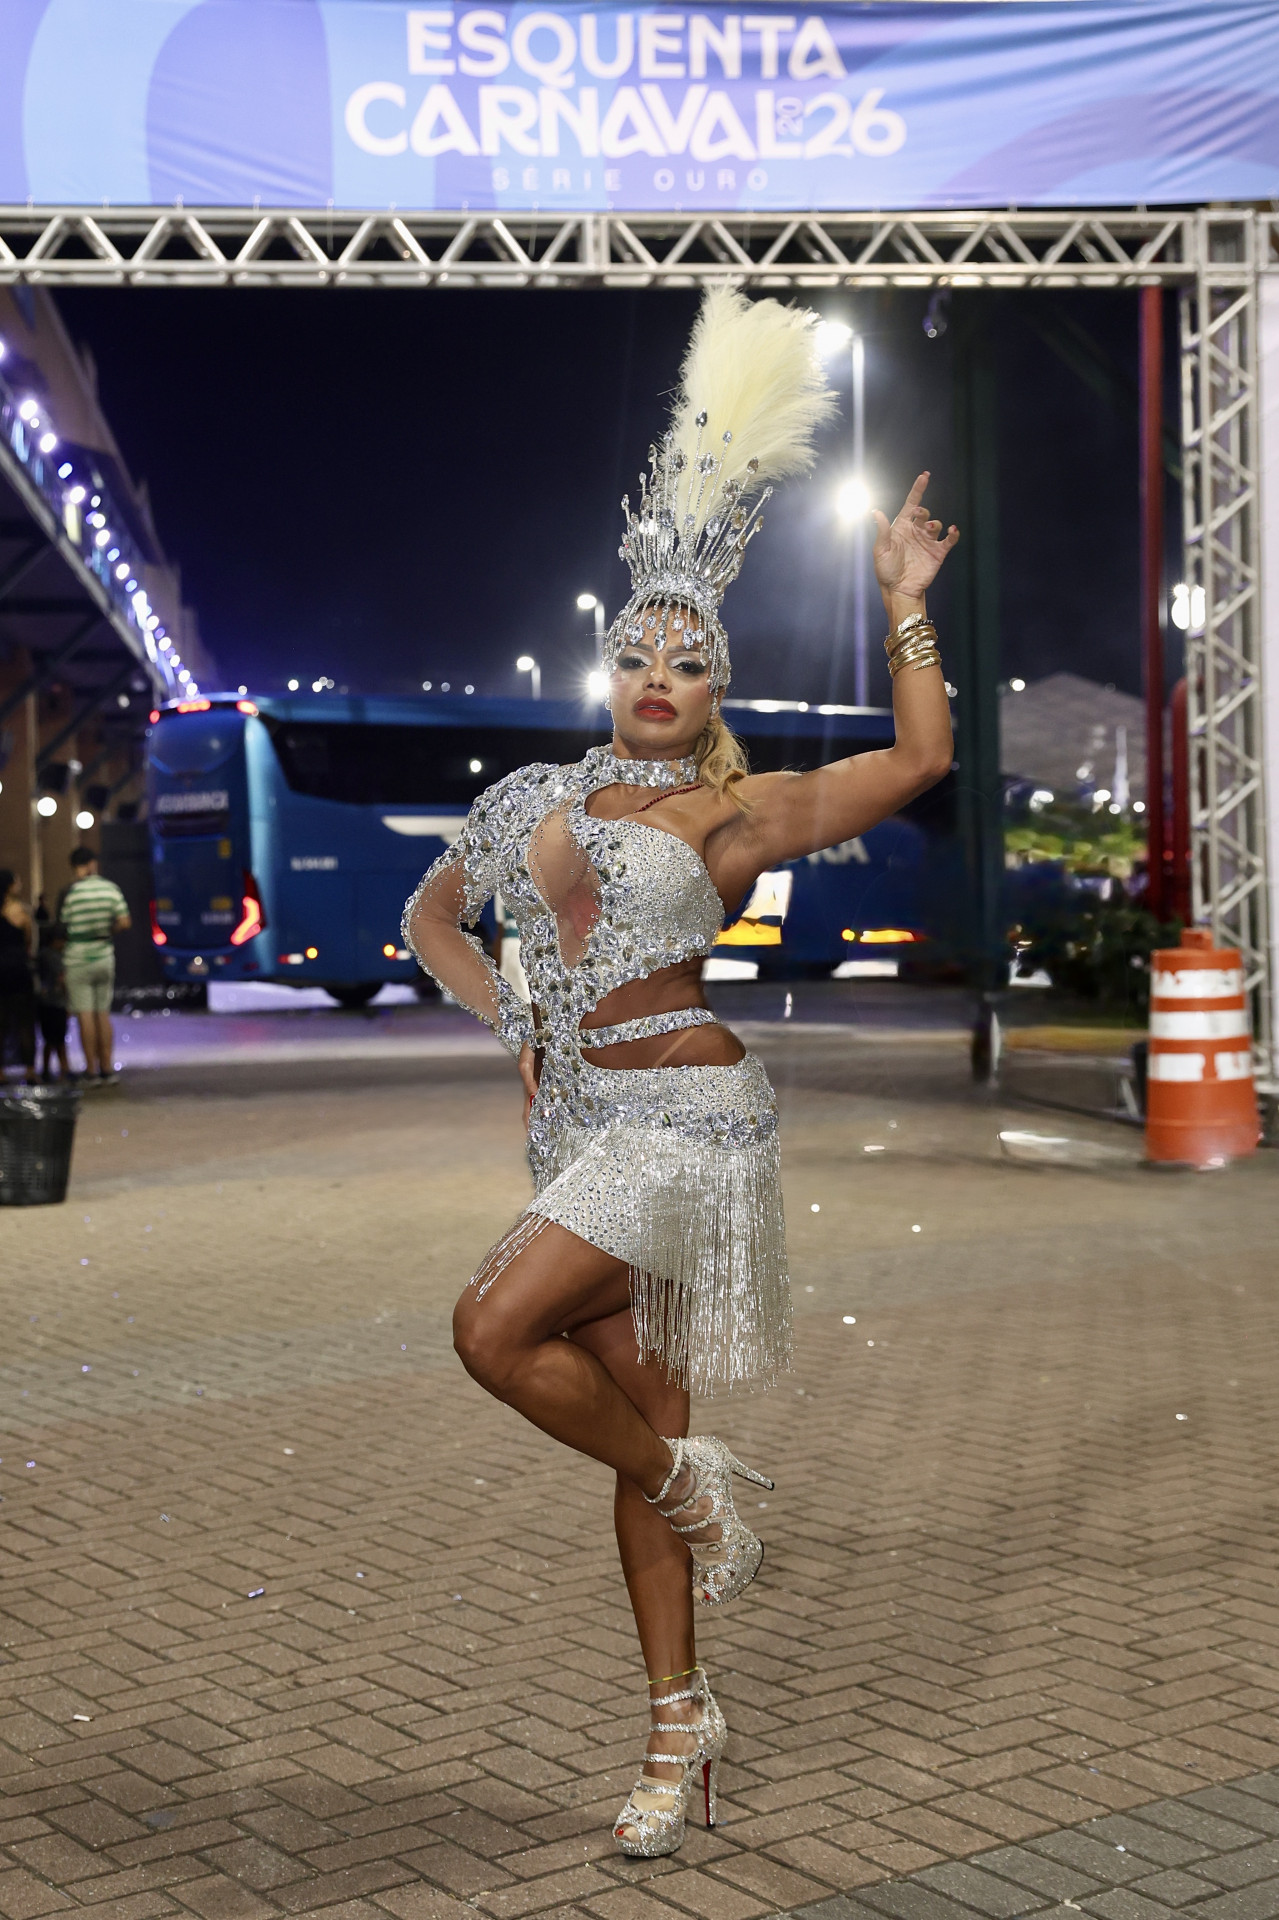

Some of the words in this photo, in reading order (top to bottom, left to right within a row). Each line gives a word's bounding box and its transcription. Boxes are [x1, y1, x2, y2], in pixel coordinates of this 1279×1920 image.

[405, 9, 848, 89] ESQUENTA
[344, 81, 803, 163] CARNAVAL
[491, 164, 623, 191] SÉRIE
[653, 167, 769, 192] OURO
